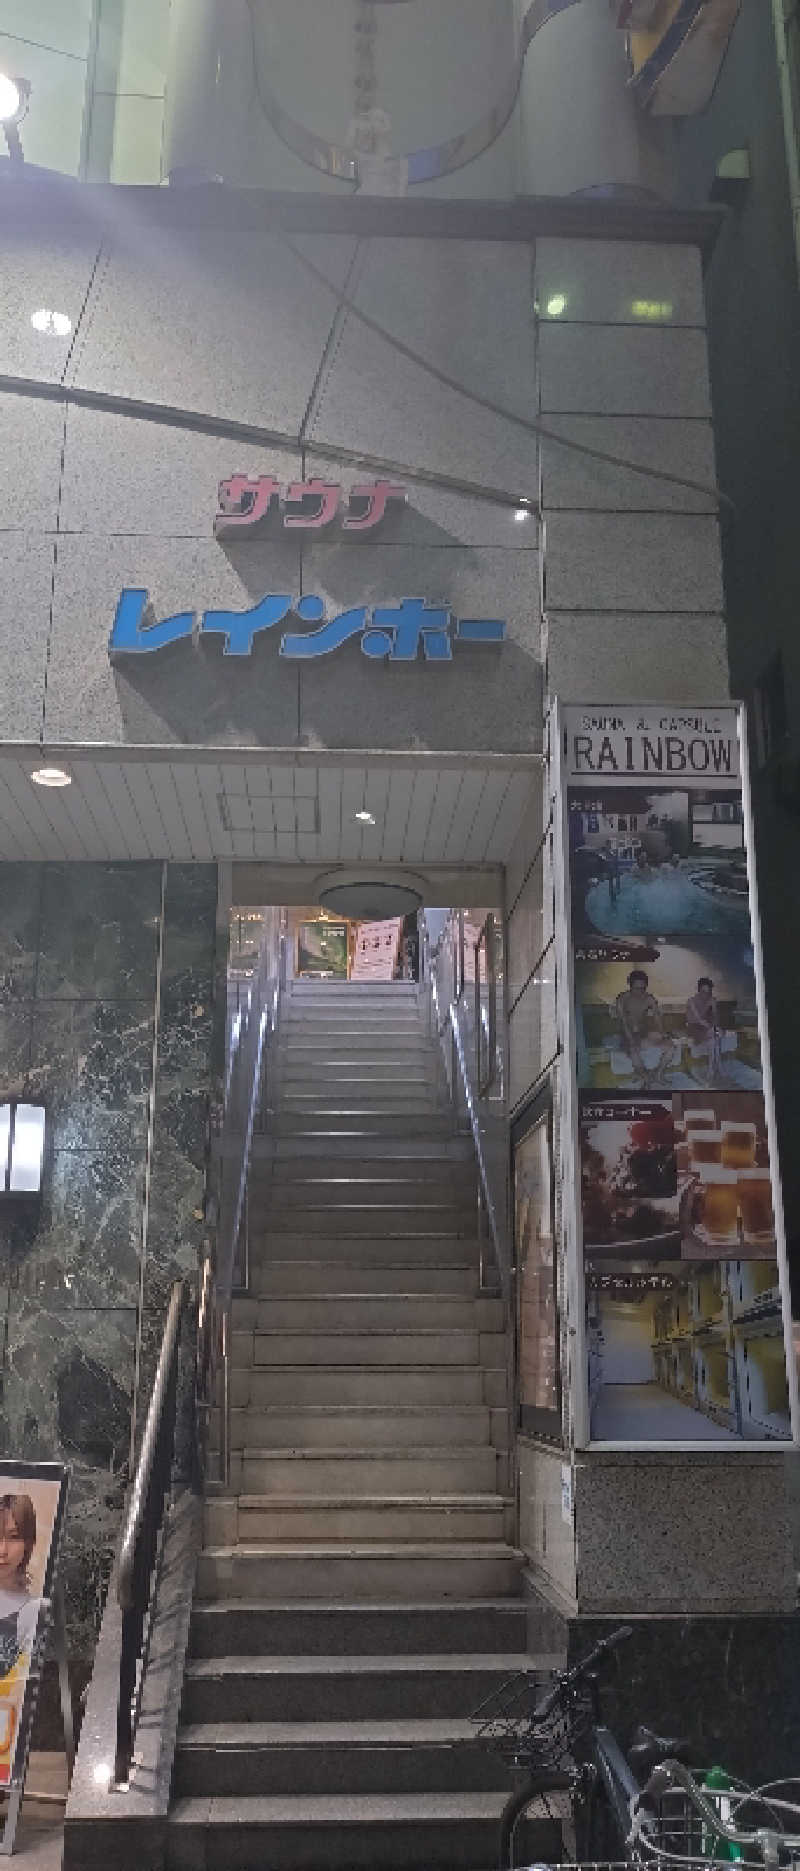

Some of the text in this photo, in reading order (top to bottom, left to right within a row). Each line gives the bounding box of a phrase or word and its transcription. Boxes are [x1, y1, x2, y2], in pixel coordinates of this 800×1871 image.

[216, 474, 407, 528] サウナ
[582, 716, 626, 731] SAUNA
[659, 717, 722, 733] CAPSULE
[573, 736, 731, 772] RAINBOW
